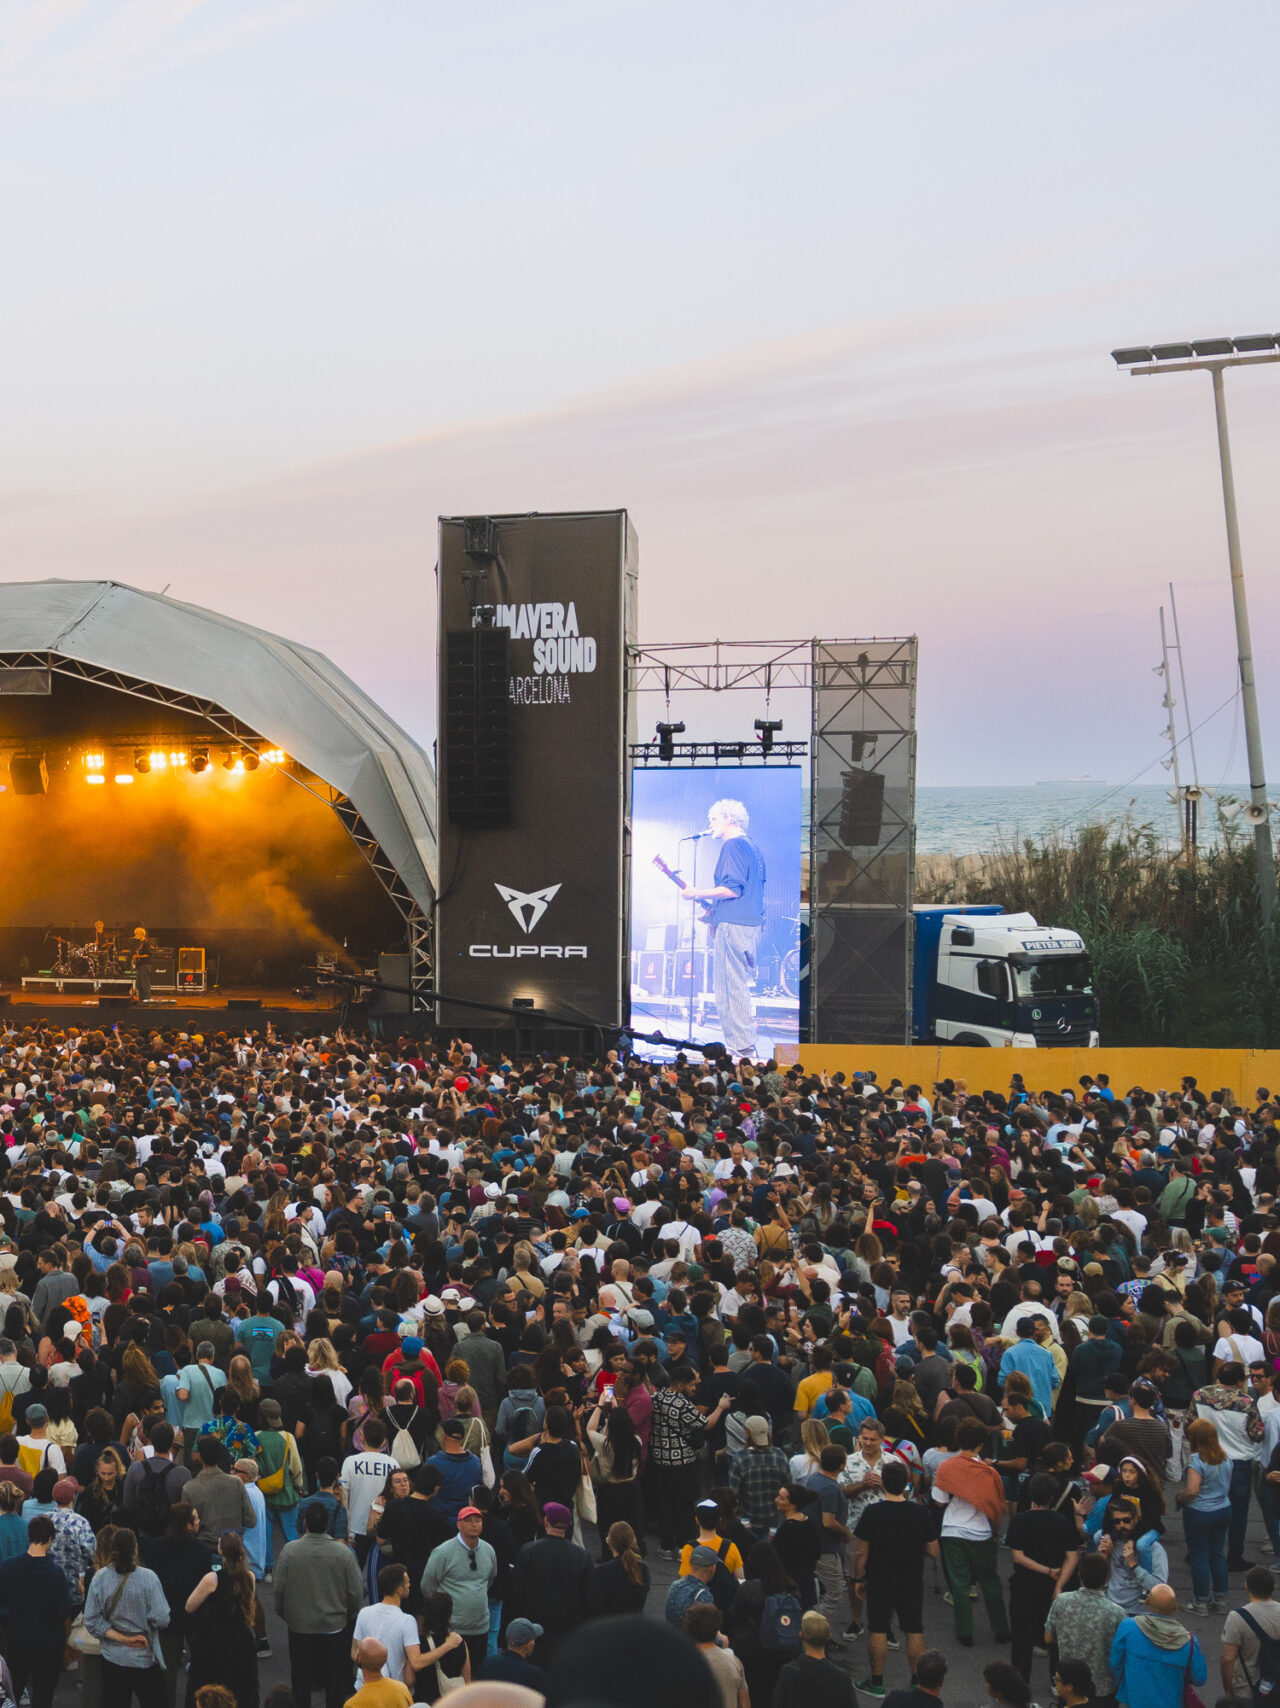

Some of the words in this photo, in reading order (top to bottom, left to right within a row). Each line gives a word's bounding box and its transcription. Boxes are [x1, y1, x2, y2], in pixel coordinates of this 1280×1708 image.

[533, 637, 597, 674] SOUND
[509, 675, 571, 704] ARCELONA
[469, 944, 588, 958] CUPRA
[1025, 941, 1060, 950] PIETER
[1060, 940, 1081, 948] SMIT
